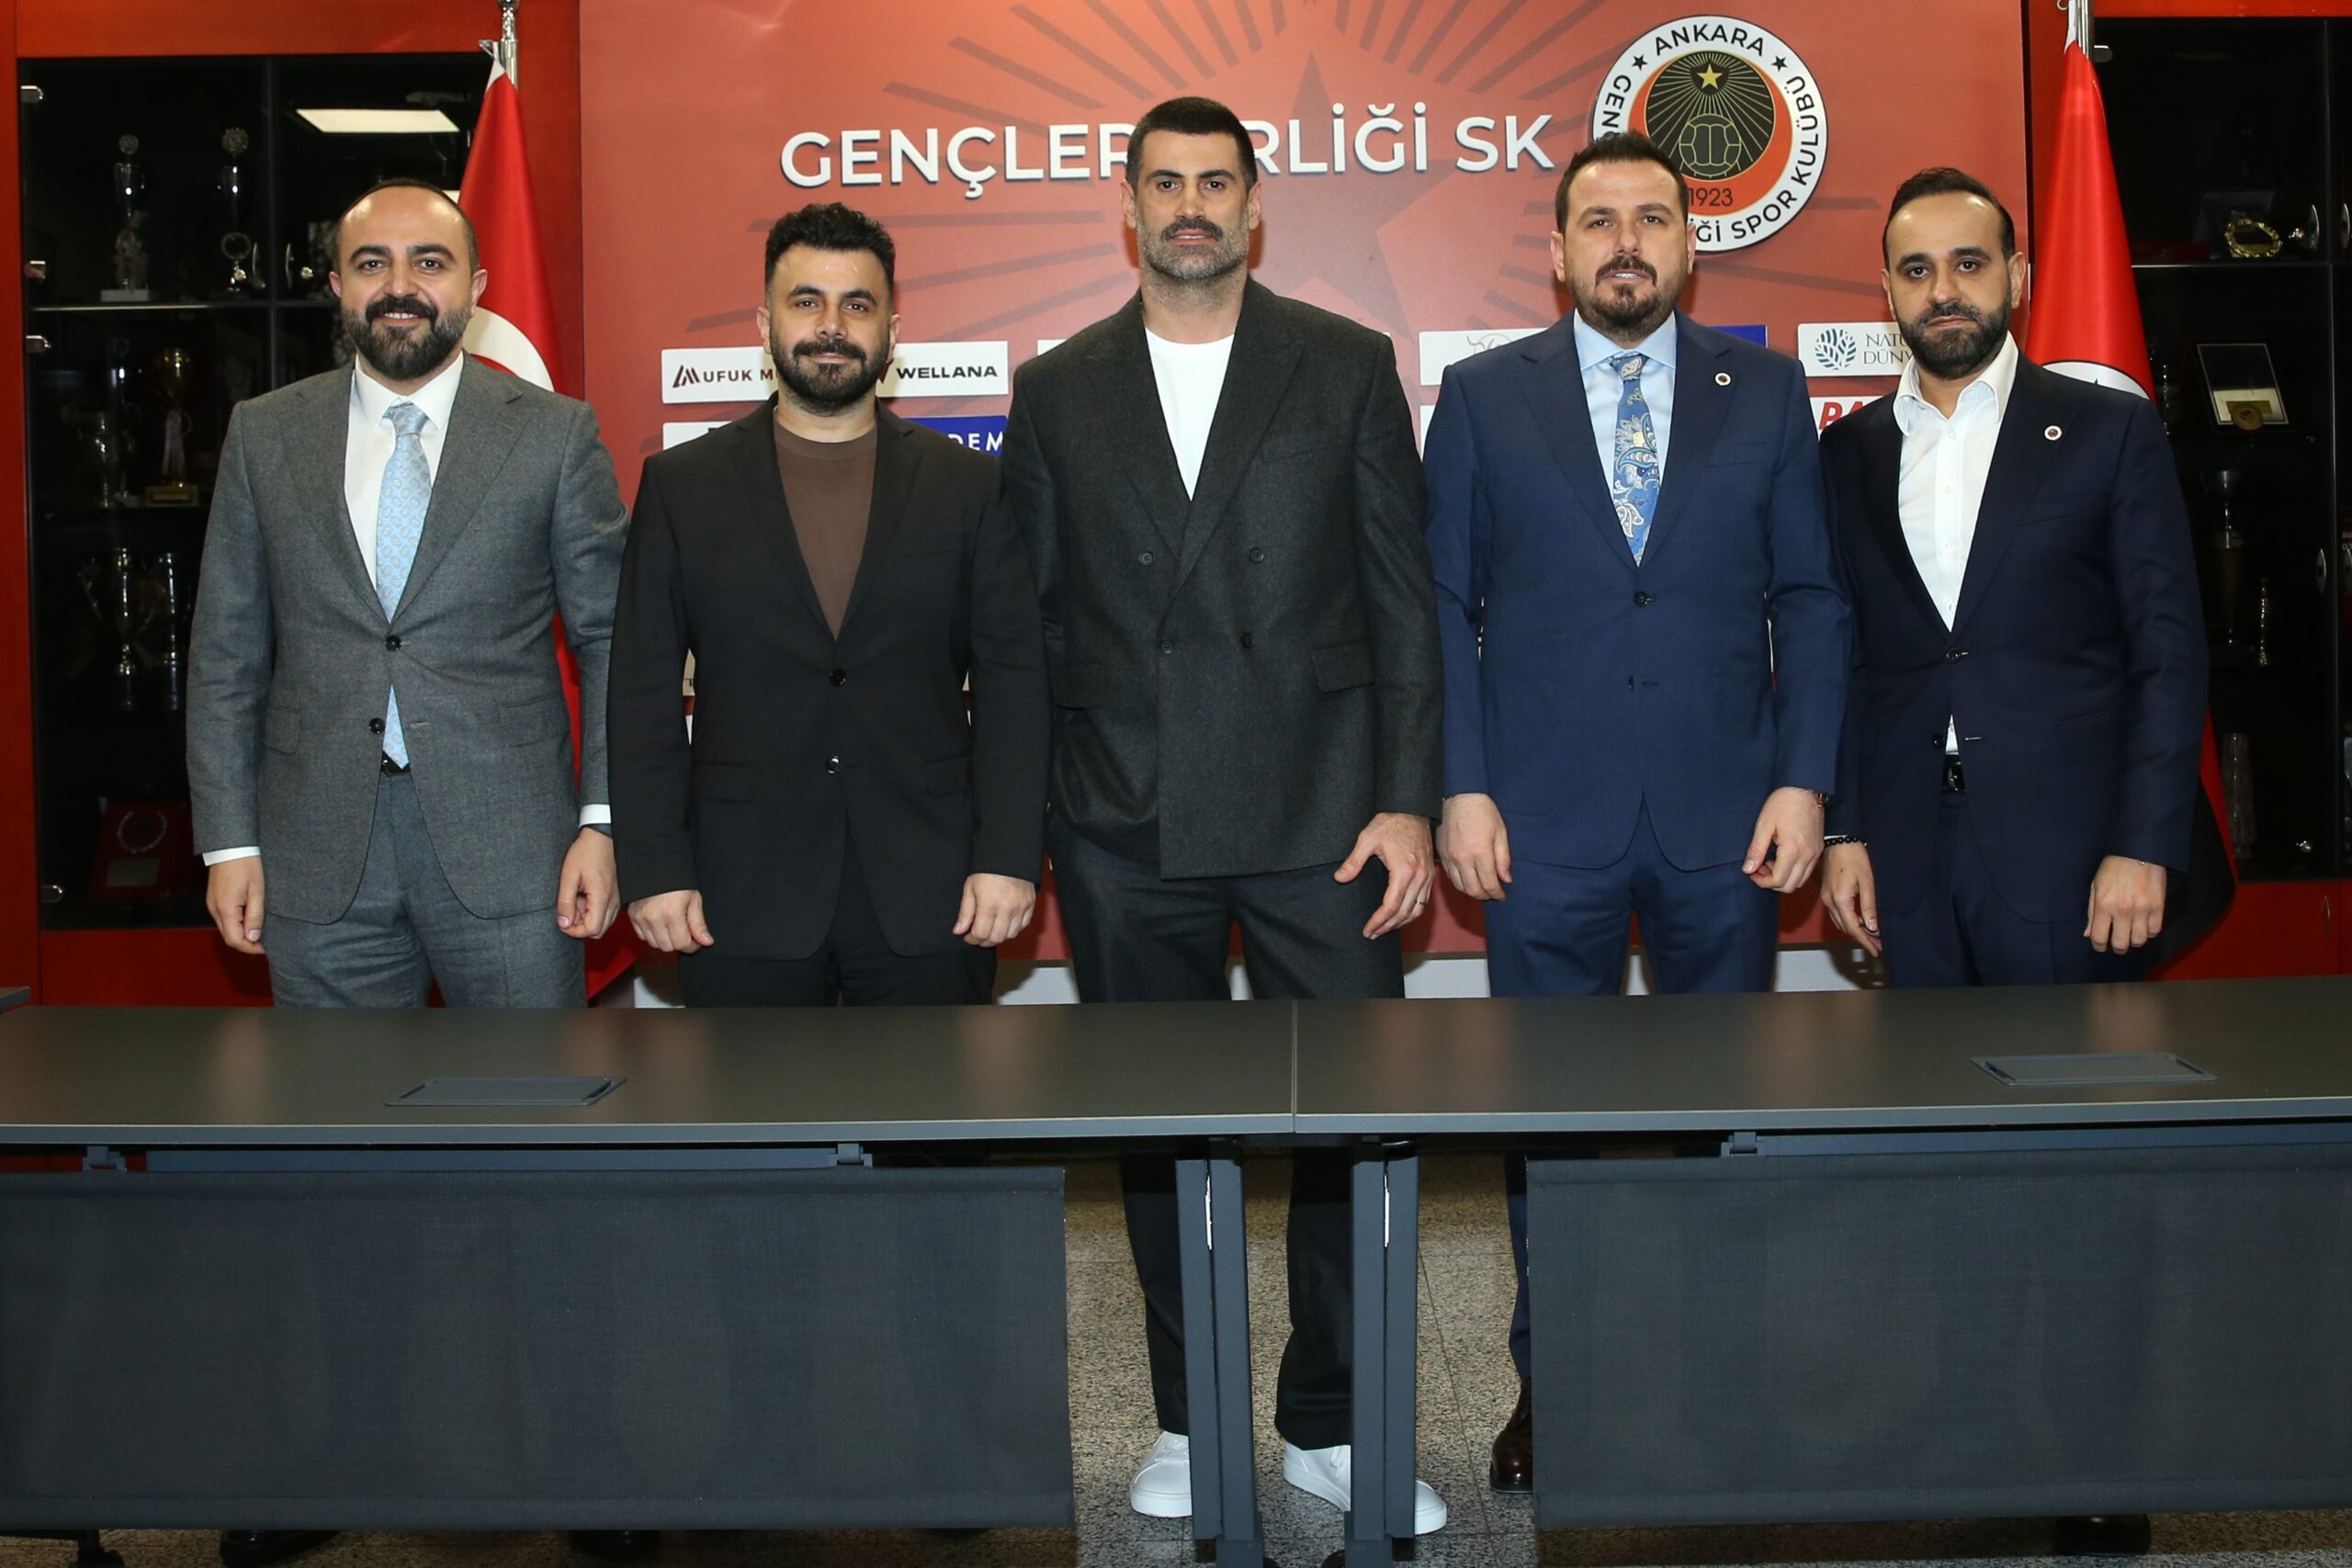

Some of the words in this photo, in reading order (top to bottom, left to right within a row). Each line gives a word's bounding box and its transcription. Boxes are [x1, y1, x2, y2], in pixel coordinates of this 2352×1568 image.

[1655, 23, 1764, 56] ANKARA
[1455, 115, 1555, 172] SK
[1732, 189, 1798, 240] SPOR
[1784, 76, 1819, 186] KULÜBÜ
[1689, 187, 1734, 207] 1923
[1863, 348, 1914, 365] DÜNY
[703, 369, 752, 383] UFUK
[897, 366, 998, 379] WELLANA
